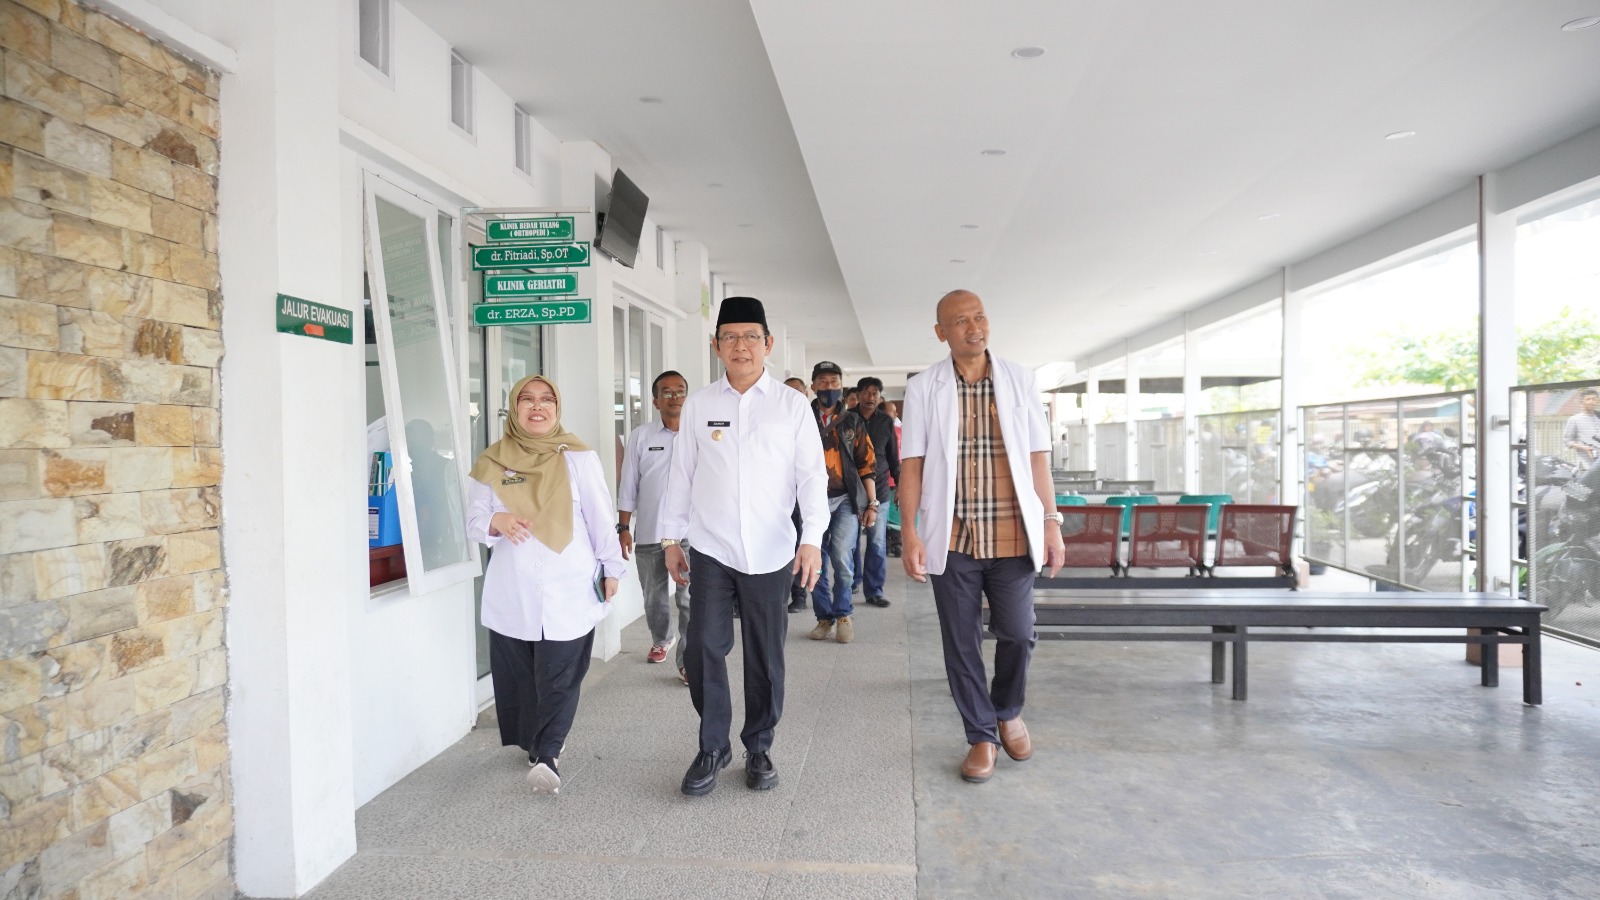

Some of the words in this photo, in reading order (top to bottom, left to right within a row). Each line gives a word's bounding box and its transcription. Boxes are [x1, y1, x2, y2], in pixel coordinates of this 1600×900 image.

[500, 222, 518, 230] KLINIK
[519, 222, 538, 230] BEDAH
[539, 221, 560, 229] TULANG
[490, 251, 503, 261] dr.
[505, 249, 540, 261] Fitriadi,
[541, 248, 569, 262] Sp.OT
[497, 280, 525, 291] KLINIK
[527, 279, 566, 290] GERIATRI
[281, 299, 309, 320] JALUR
[310, 305, 350, 328] EVAKUASI
[487, 310, 502, 319] dr.
[505, 308, 539, 319] ERZA,
[541, 307, 576, 319] Sp.PD
